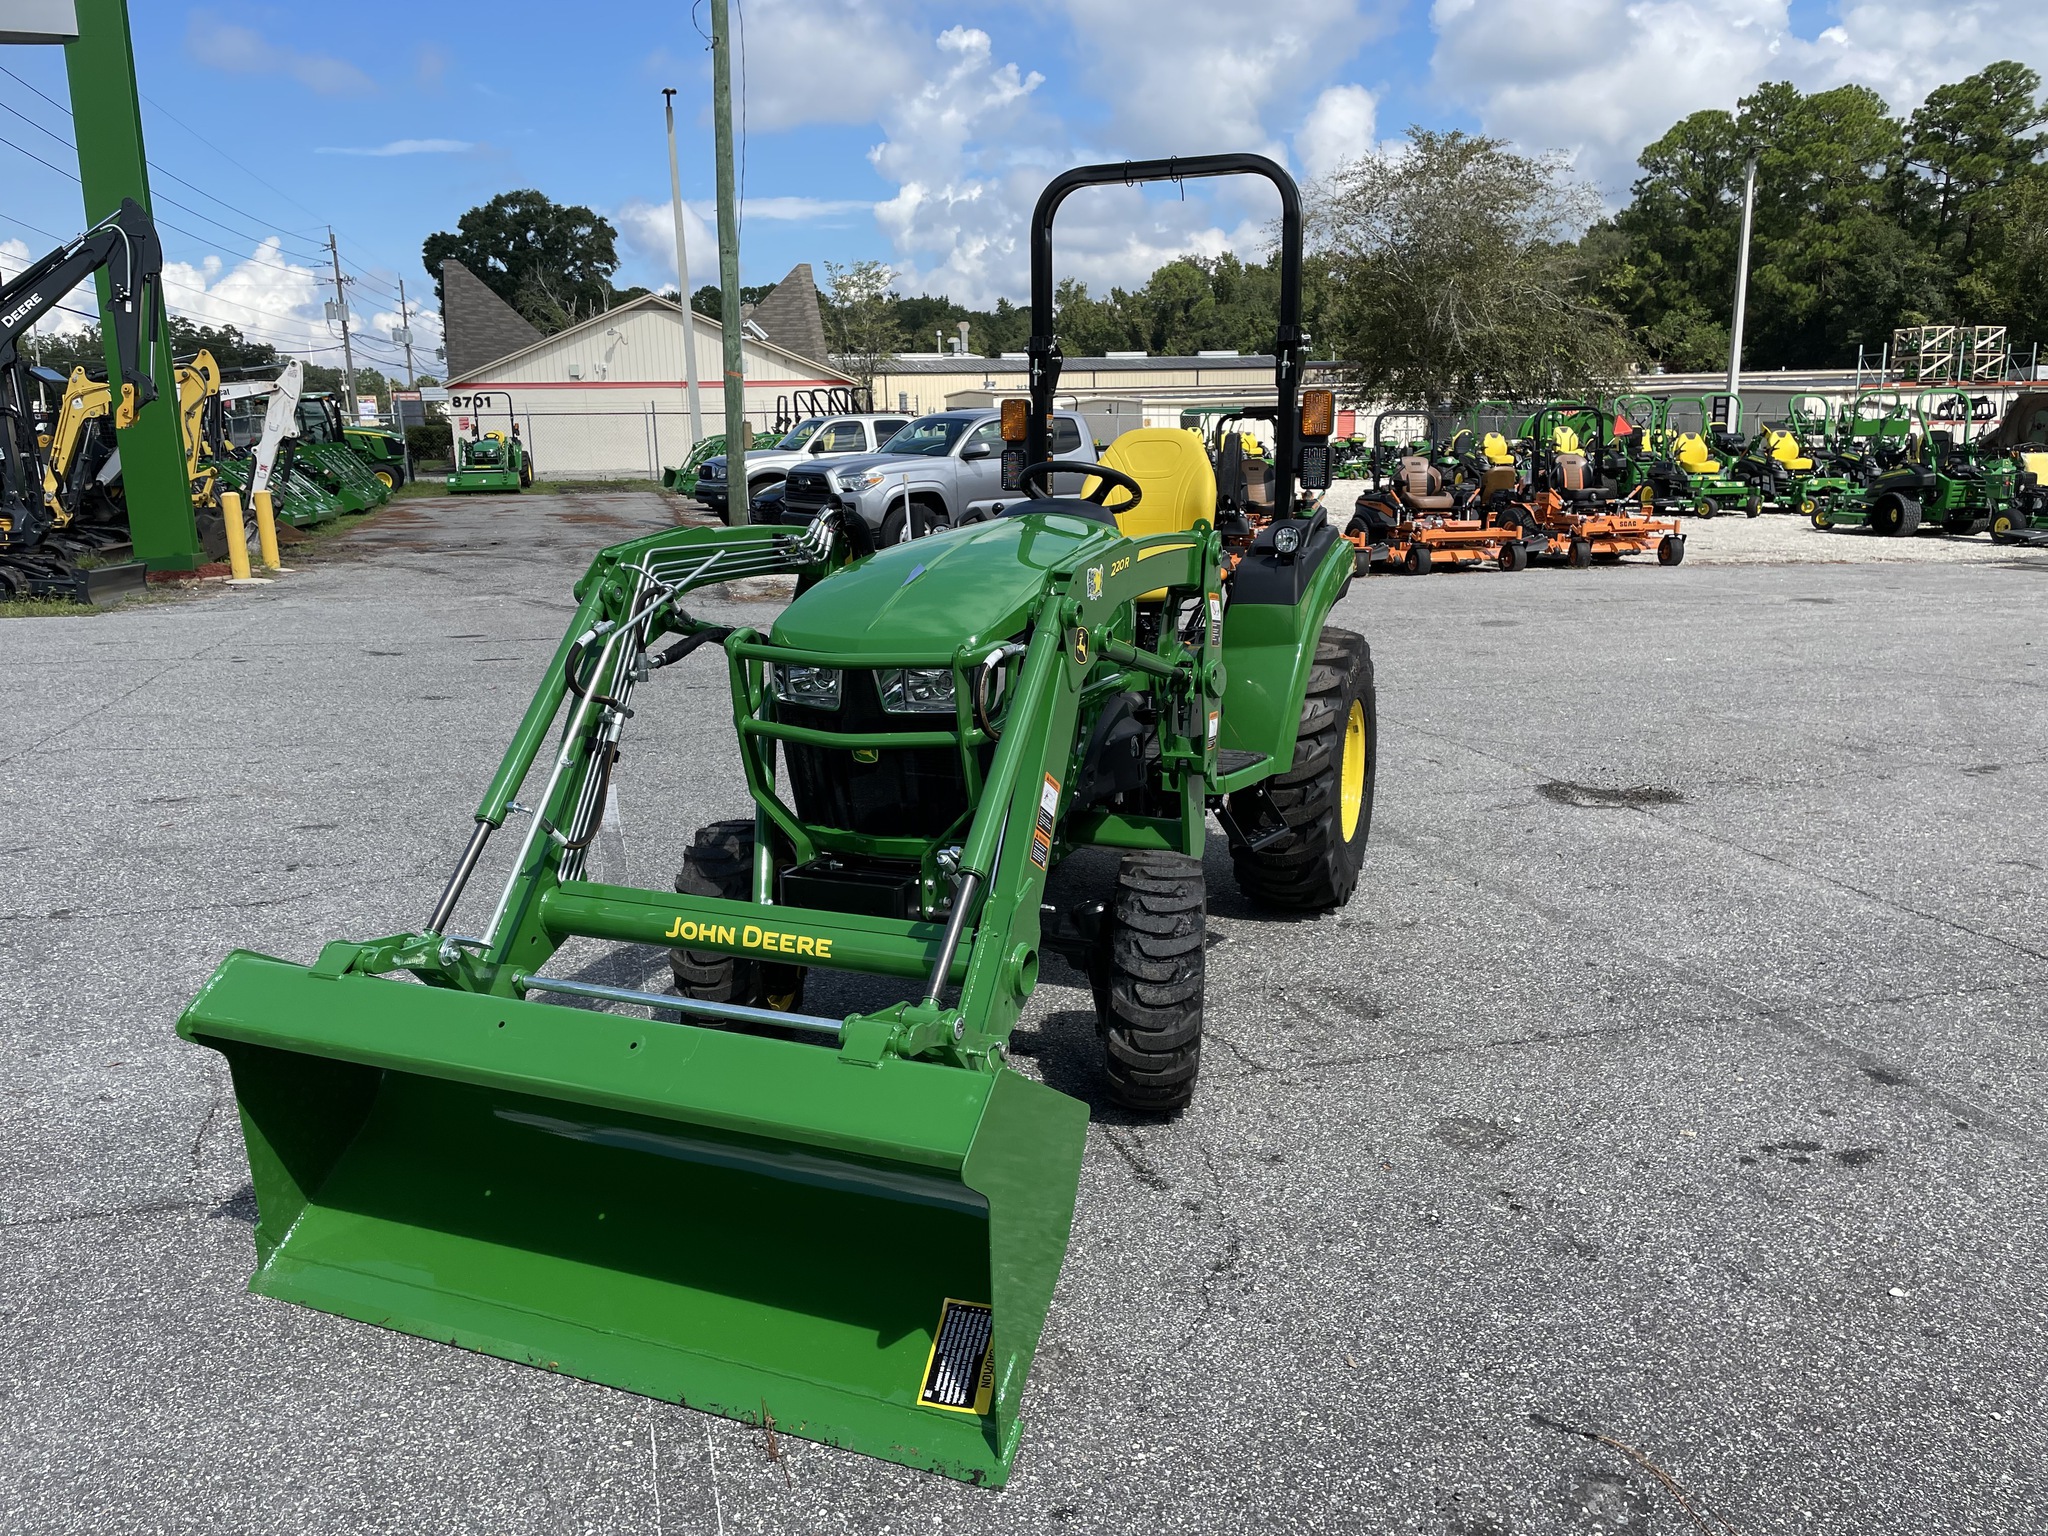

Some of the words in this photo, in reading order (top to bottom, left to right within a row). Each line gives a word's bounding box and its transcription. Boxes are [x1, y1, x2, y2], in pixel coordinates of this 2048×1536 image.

[1, 292, 43, 328] DEERE
[452, 396, 491, 408] 8701
[665, 916, 736, 946] JOHN
[742, 925, 833, 959] DEERE
